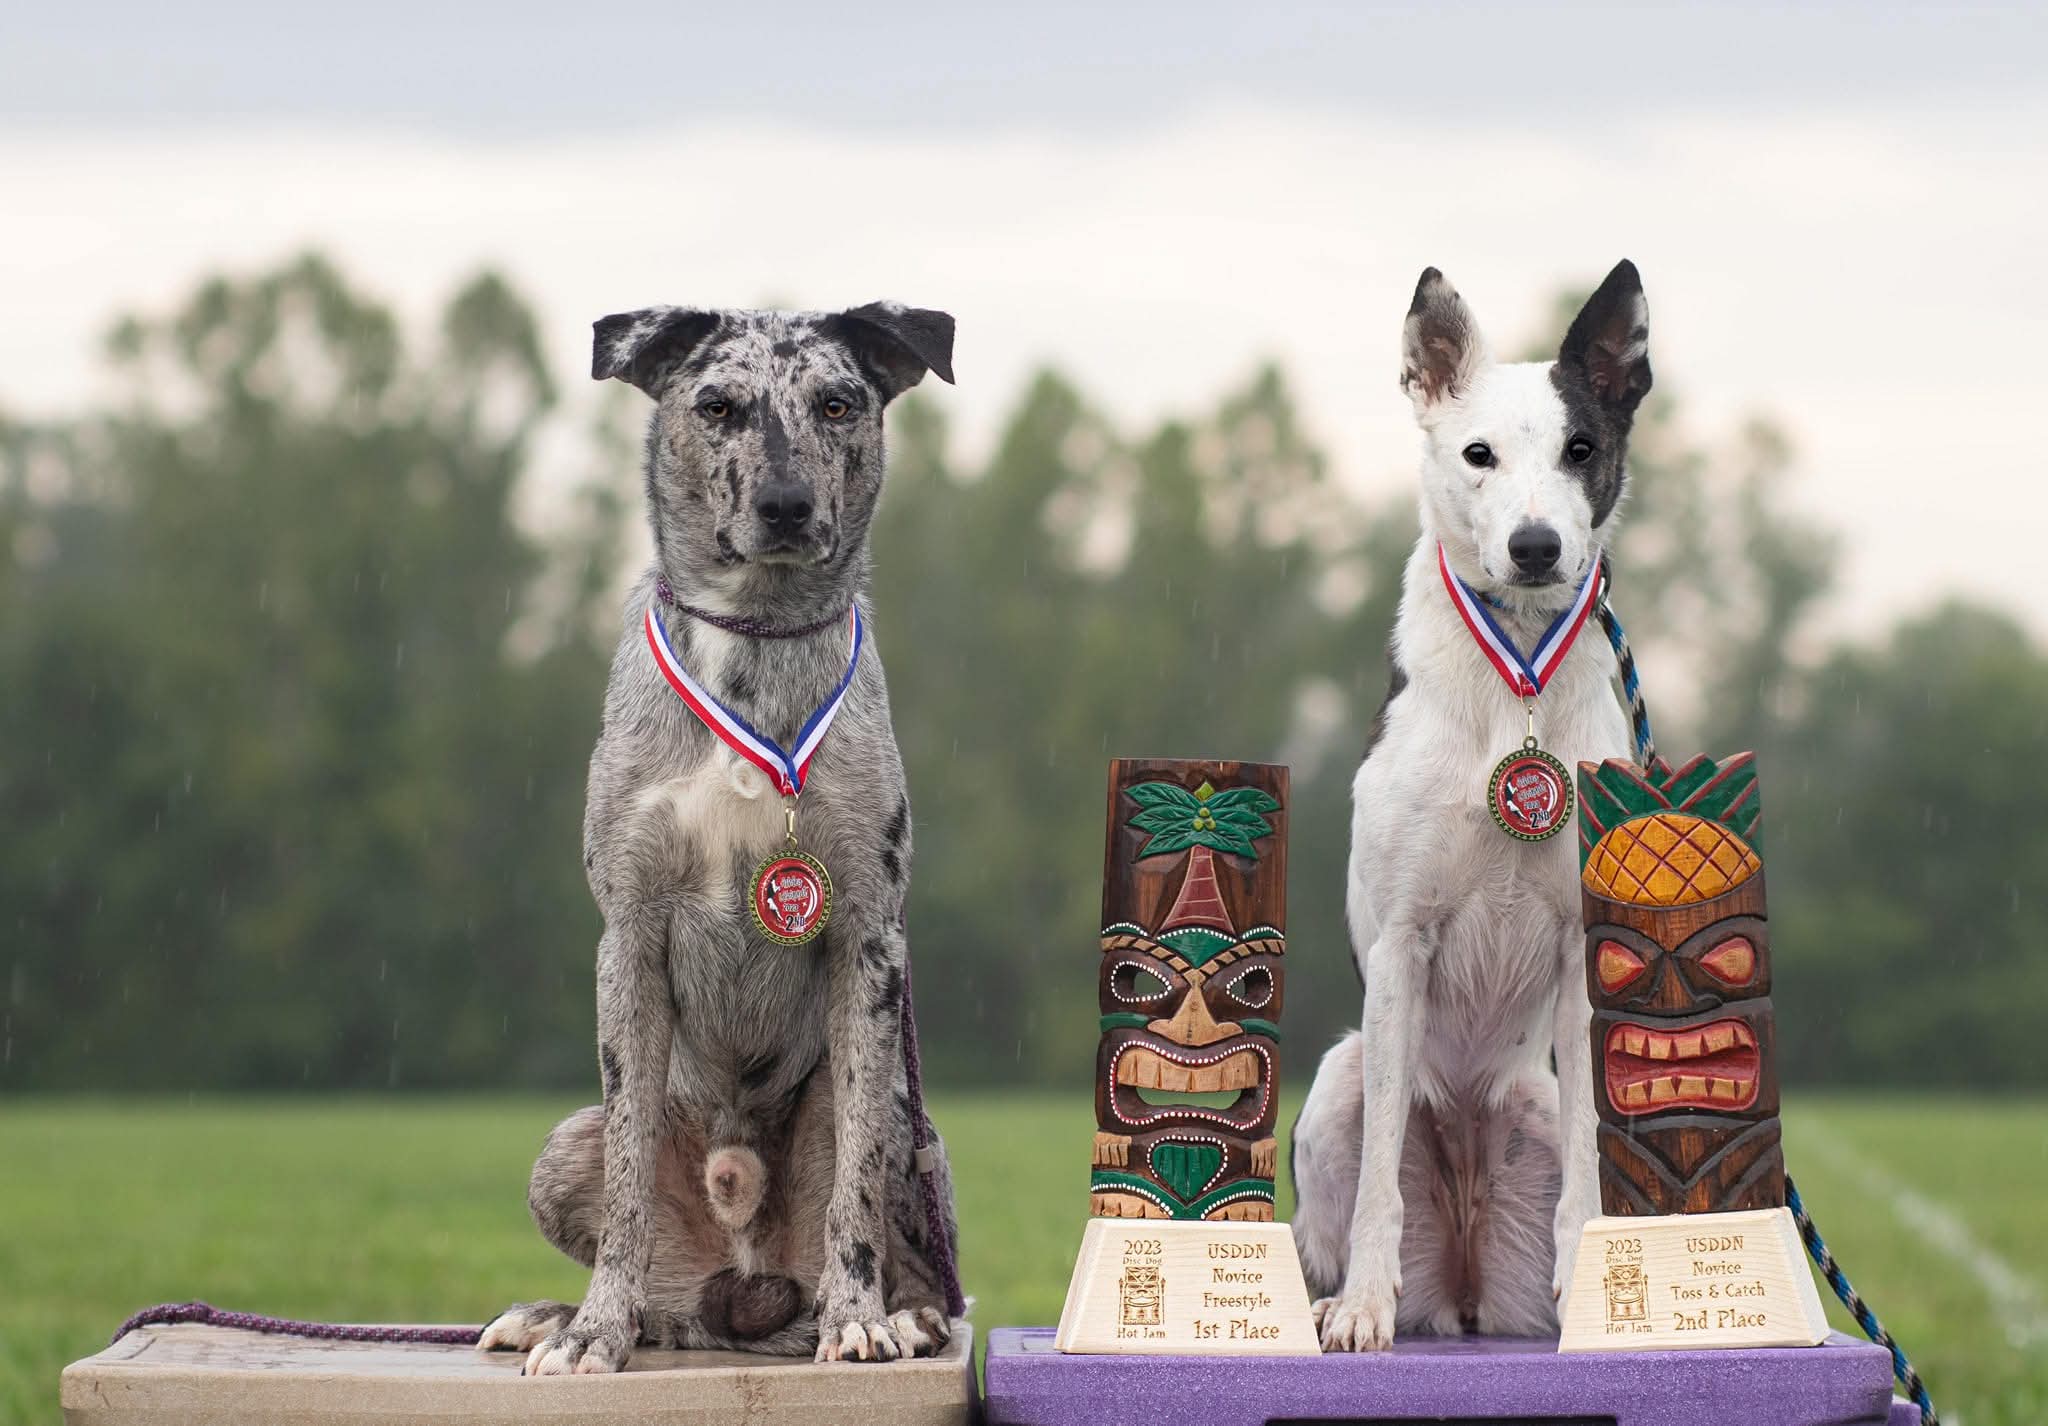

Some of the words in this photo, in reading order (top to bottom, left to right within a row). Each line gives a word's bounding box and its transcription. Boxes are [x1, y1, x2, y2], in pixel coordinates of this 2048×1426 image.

[1124, 1240, 1162, 1255] 2023
[1208, 1244, 1267, 1259] USDDN
[1606, 1239, 1642, 1254] 2023
[1686, 1236, 1743, 1252] USDDN
[1146, 1257, 1162, 1265] Dog
[1627, 1255, 1643, 1264] Dog
[1213, 1269, 1262, 1283] Novice
[1693, 1261, 1741, 1276] Novice
[1671, 1286, 1702, 1300] Toss
[1709, 1285, 1720, 1297] &
[1725, 1281, 1765, 1297] Catch
[1203, 1293, 1271, 1311] Freestyle
[1674, 1311, 1708, 1331] 2nd
[1717, 1309, 1766, 1328] Place
[1117, 1328, 1137, 1338] Hot
[1144, 1328, 1165, 1338] Jam
[1194, 1320, 1220, 1339] 1st
[1229, 1320, 1280, 1339] Place
[1606, 1324, 1625, 1334] Hot
[1632, 1323, 1652, 1333] Jam
